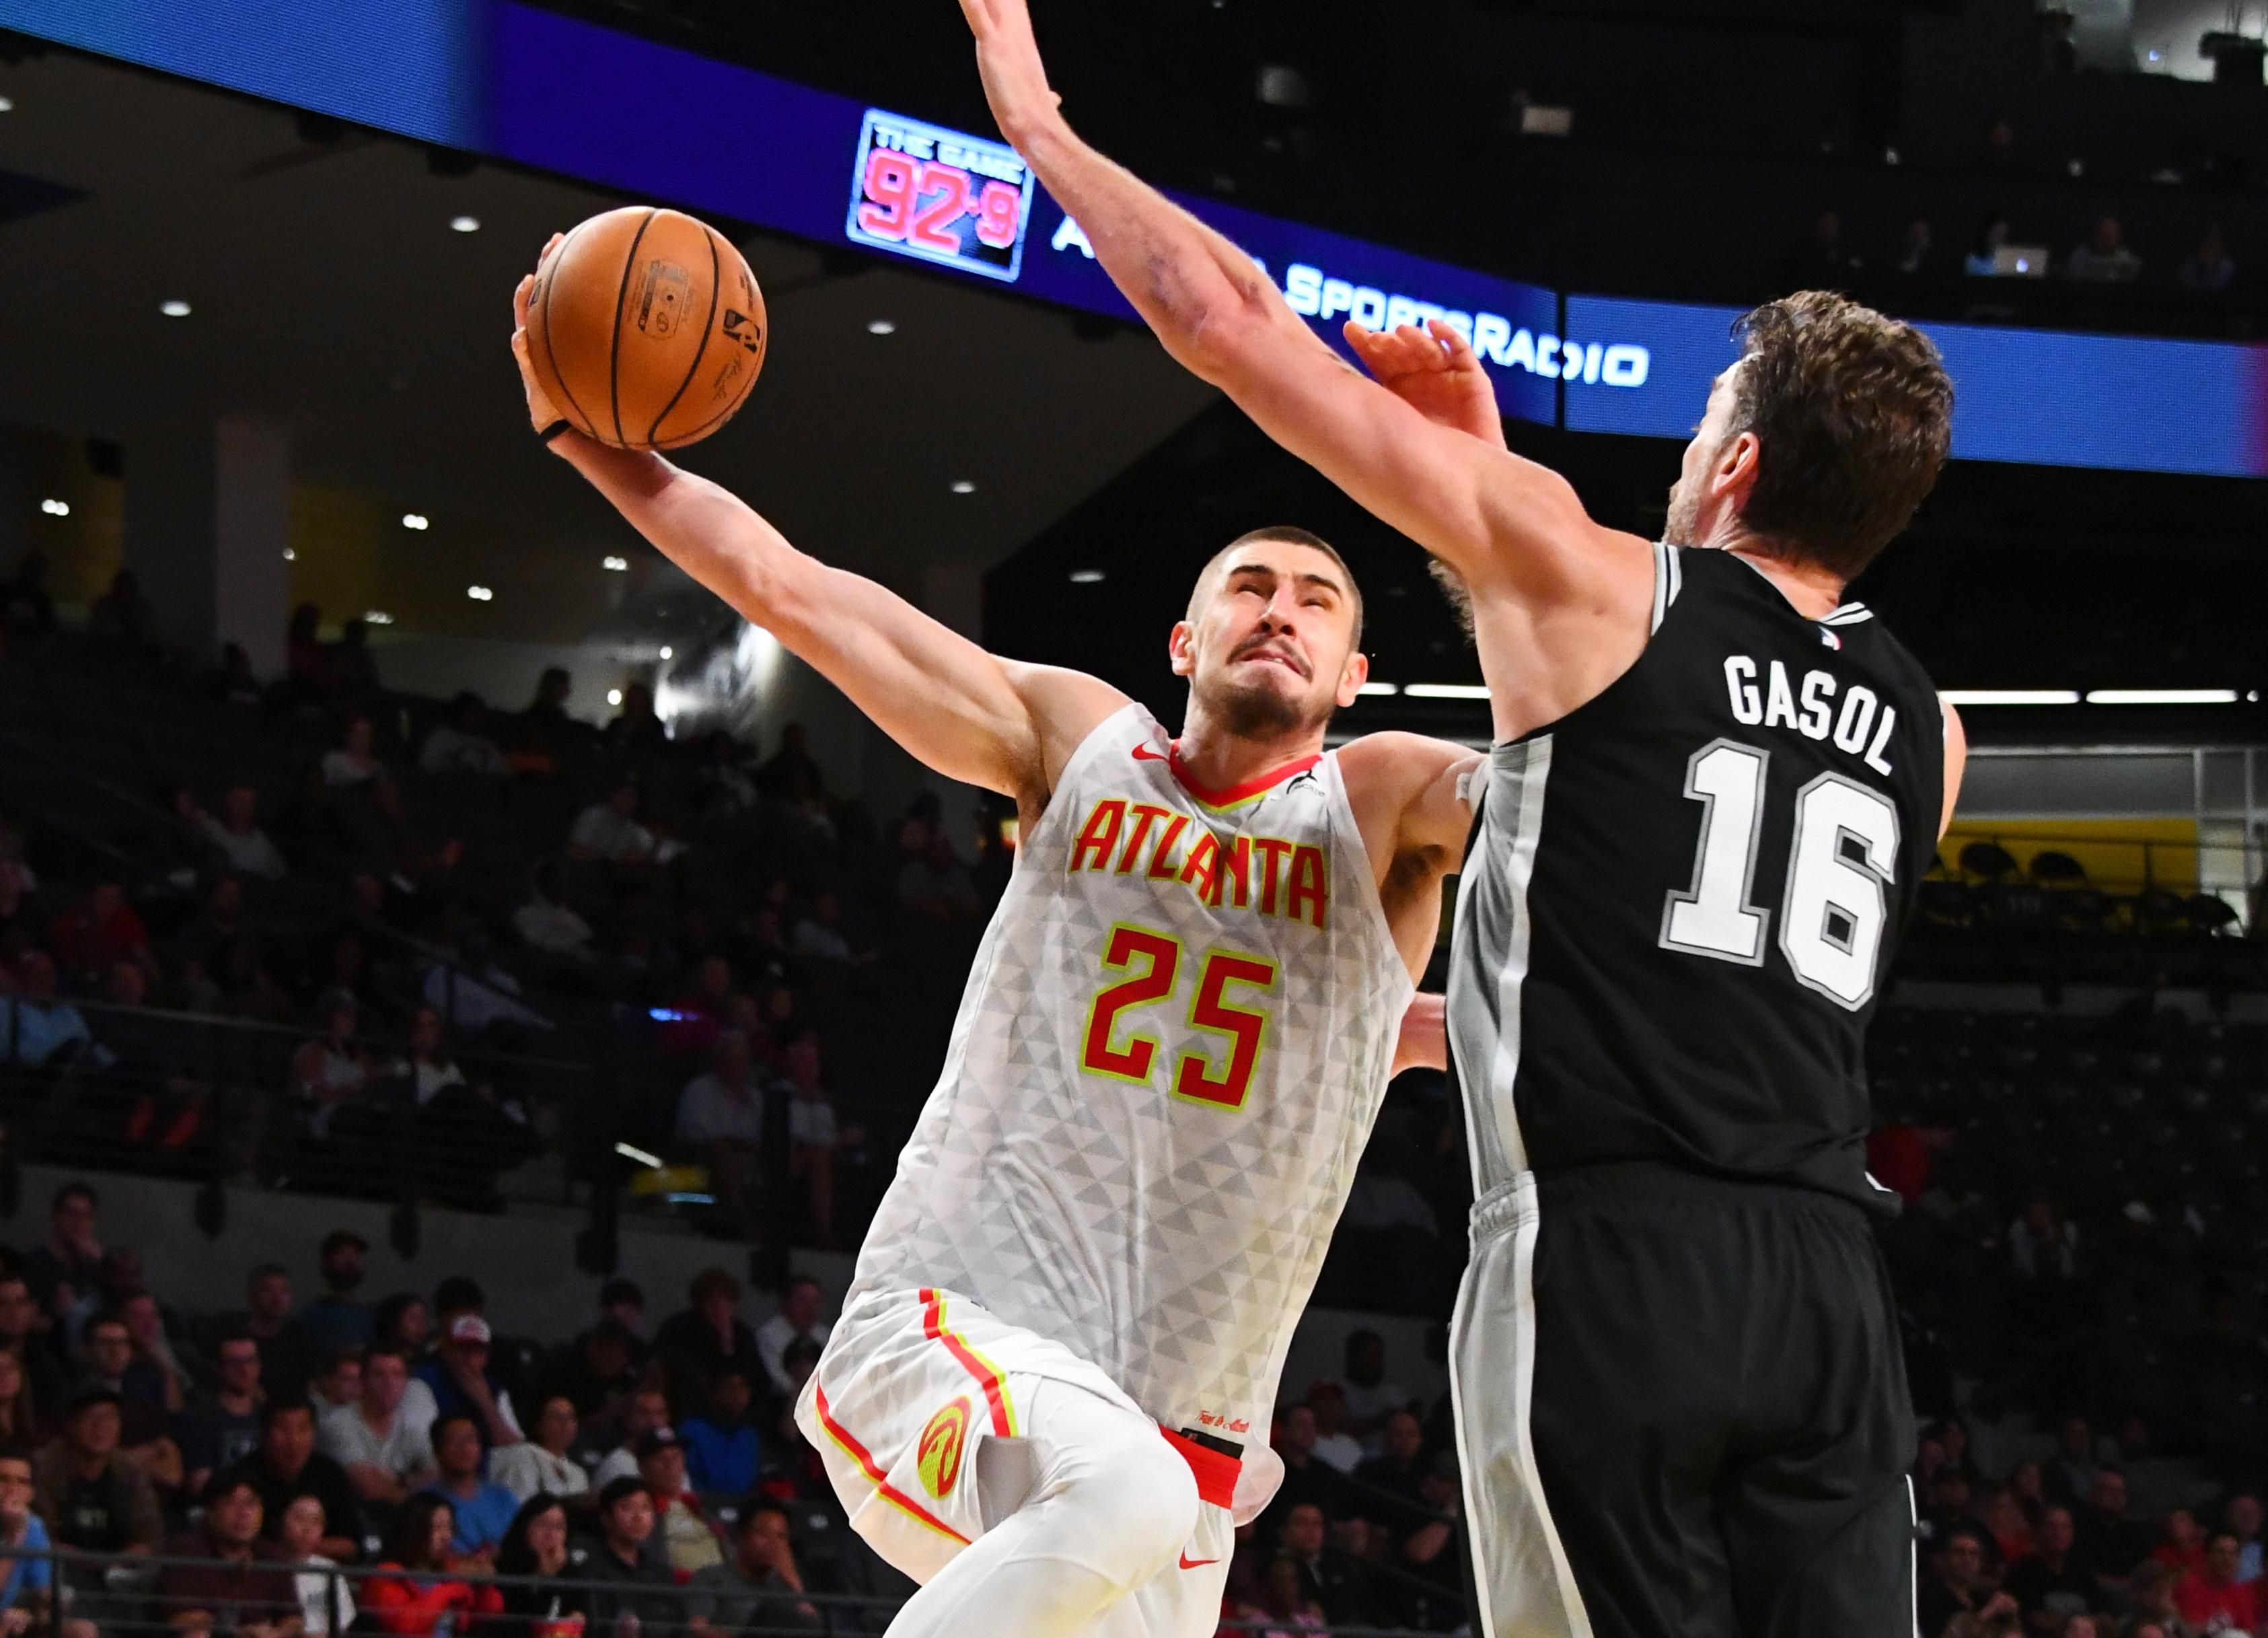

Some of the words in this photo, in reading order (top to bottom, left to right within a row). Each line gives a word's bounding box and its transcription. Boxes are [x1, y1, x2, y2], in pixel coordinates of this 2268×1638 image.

[1723, 655, 1896, 777] GASOL
[1070, 796, 1331, 931] ATLANTA
[1657, 737, 1901, 1012] 16
[1078, 920, 1279, 1119] 25
